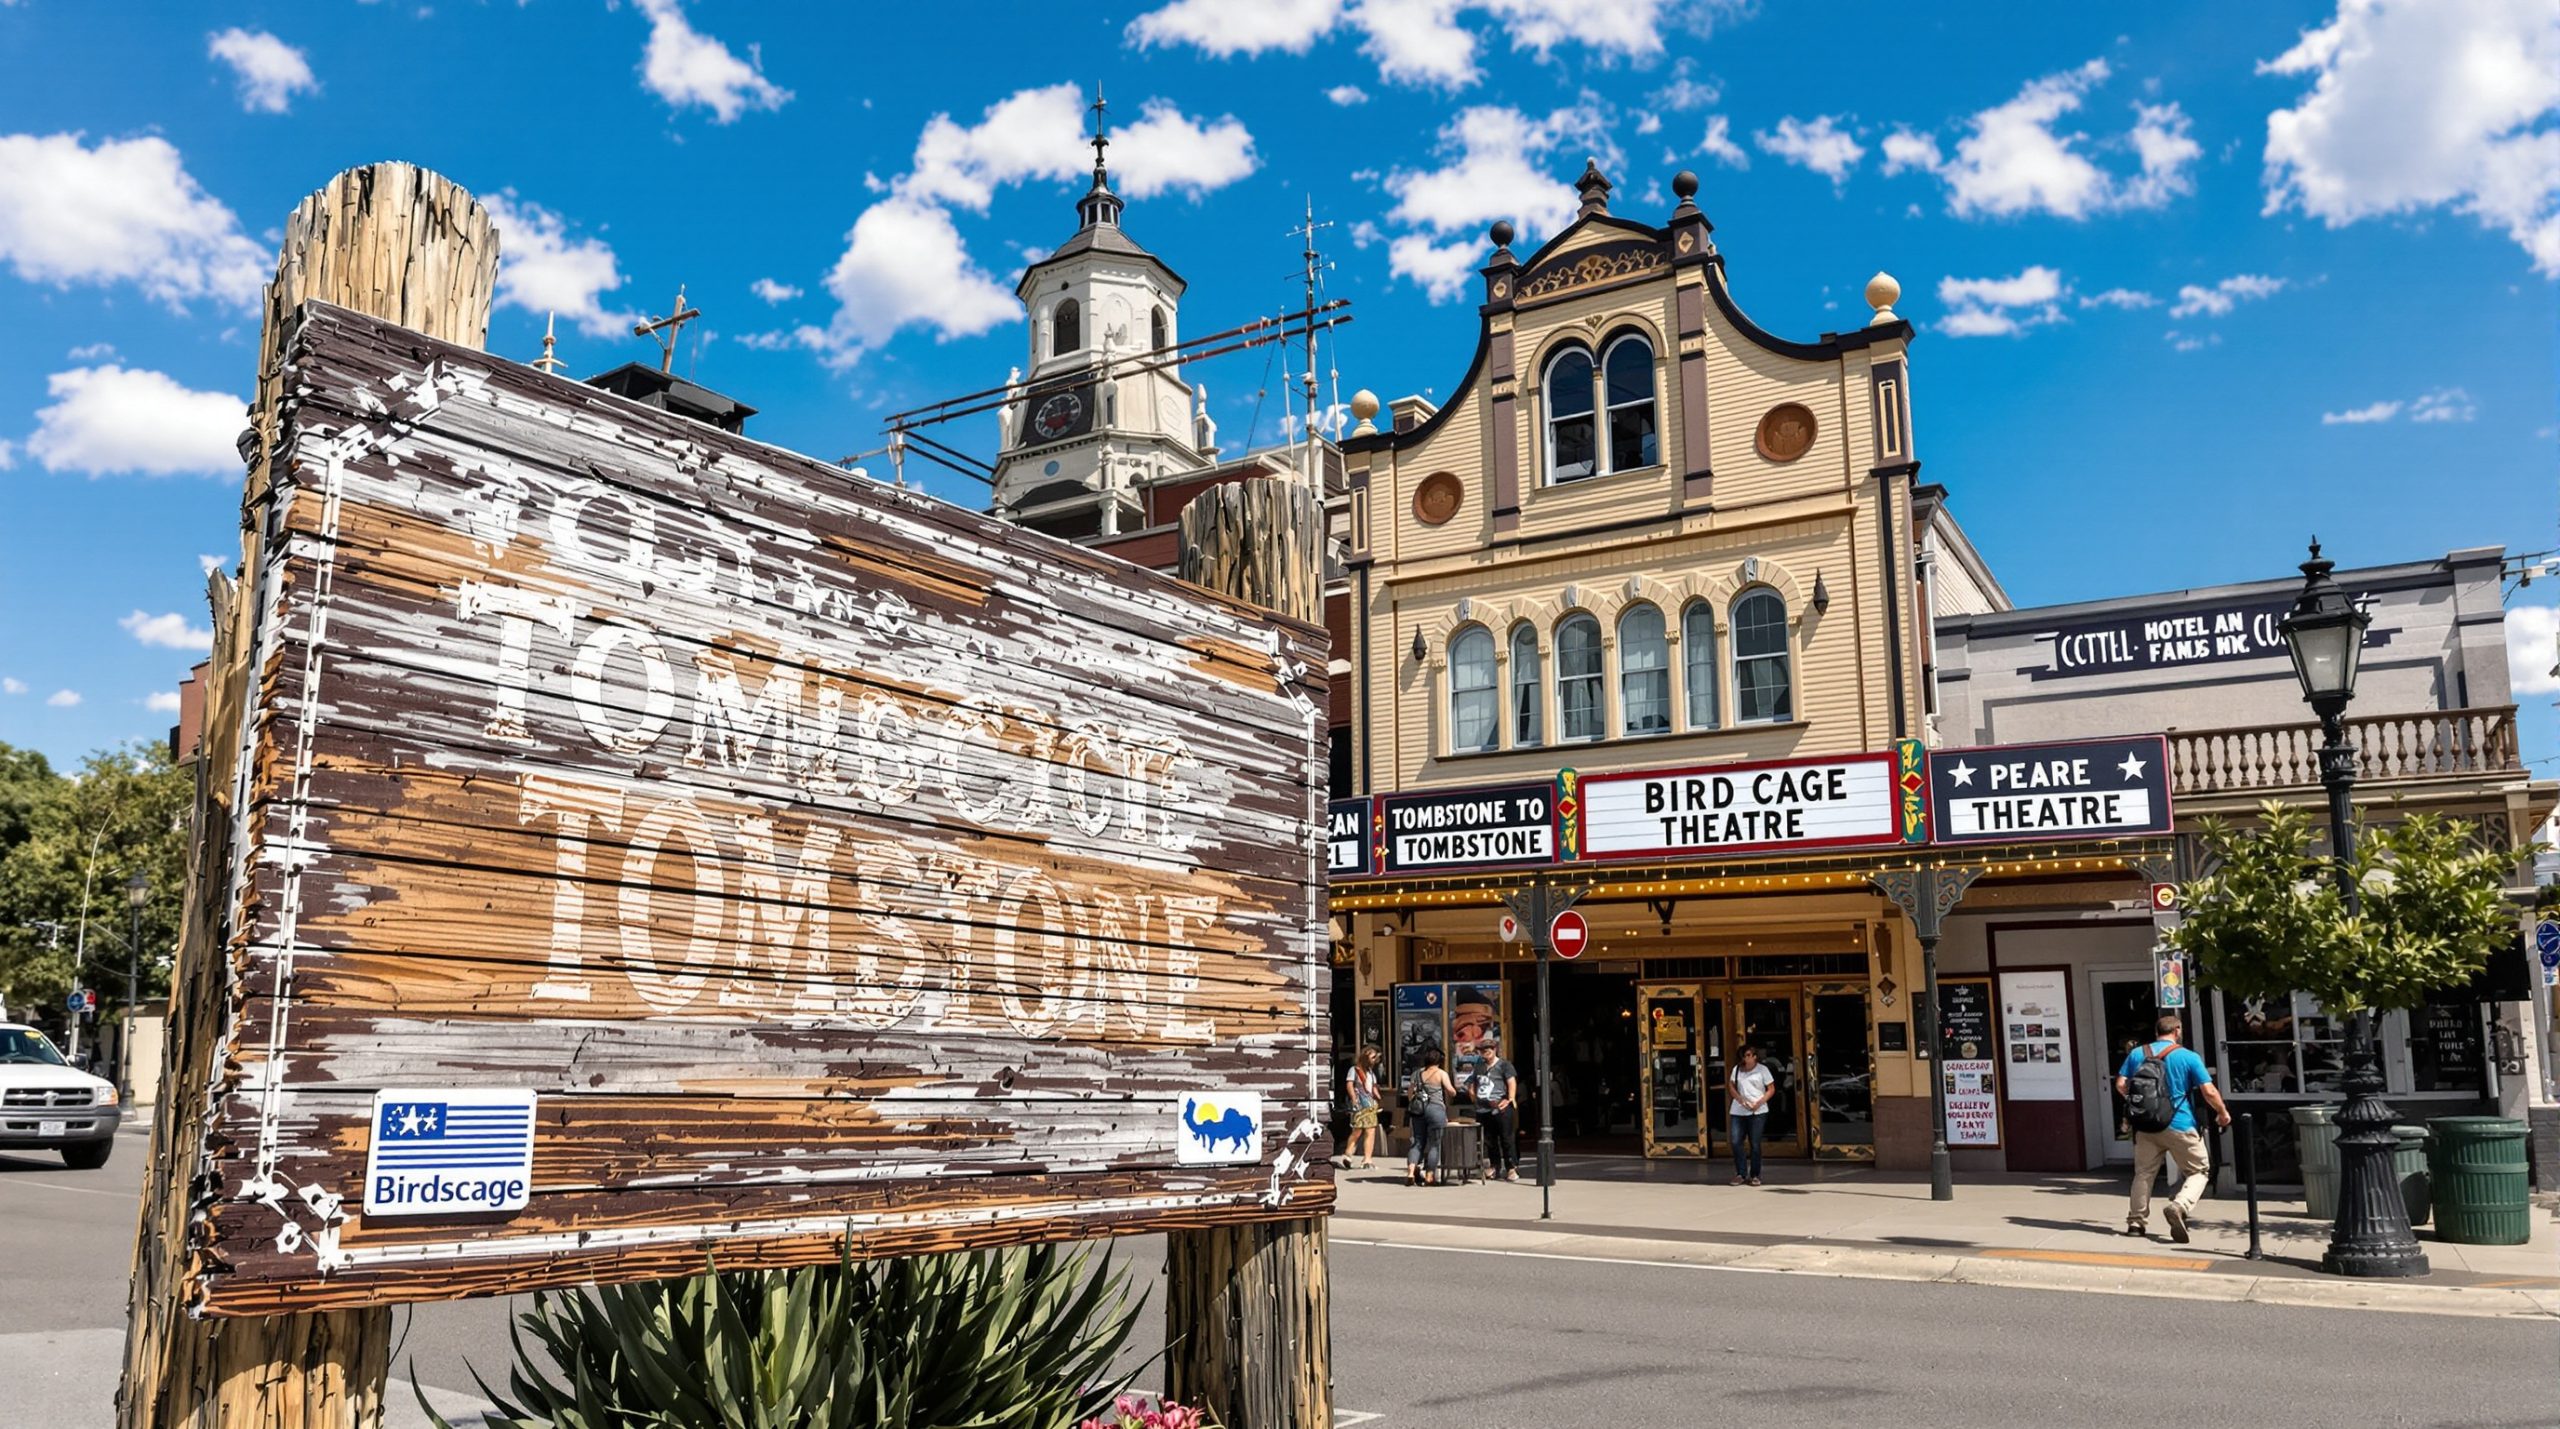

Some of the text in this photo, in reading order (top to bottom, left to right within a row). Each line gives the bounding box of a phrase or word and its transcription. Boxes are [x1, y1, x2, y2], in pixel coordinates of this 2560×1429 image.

[2144, 612, 2244, 641] HOTEL AN
[1645, 768, 1847, 814] BIRD CAGE
[1990, 759, 2091, 790] PEARE
[1392, 798, 1544, 830] TOMBSTONE TO
[1660, 808, 1804, 846] THEATRE
[1972, 794, 2122, 831] THEATRE
[1404, 829, 1543, 862] TOMBSTONE
[517, 773, 1220, 1045] TOMBSTONE
[375, 1174, 524, 1208] Birdscage
